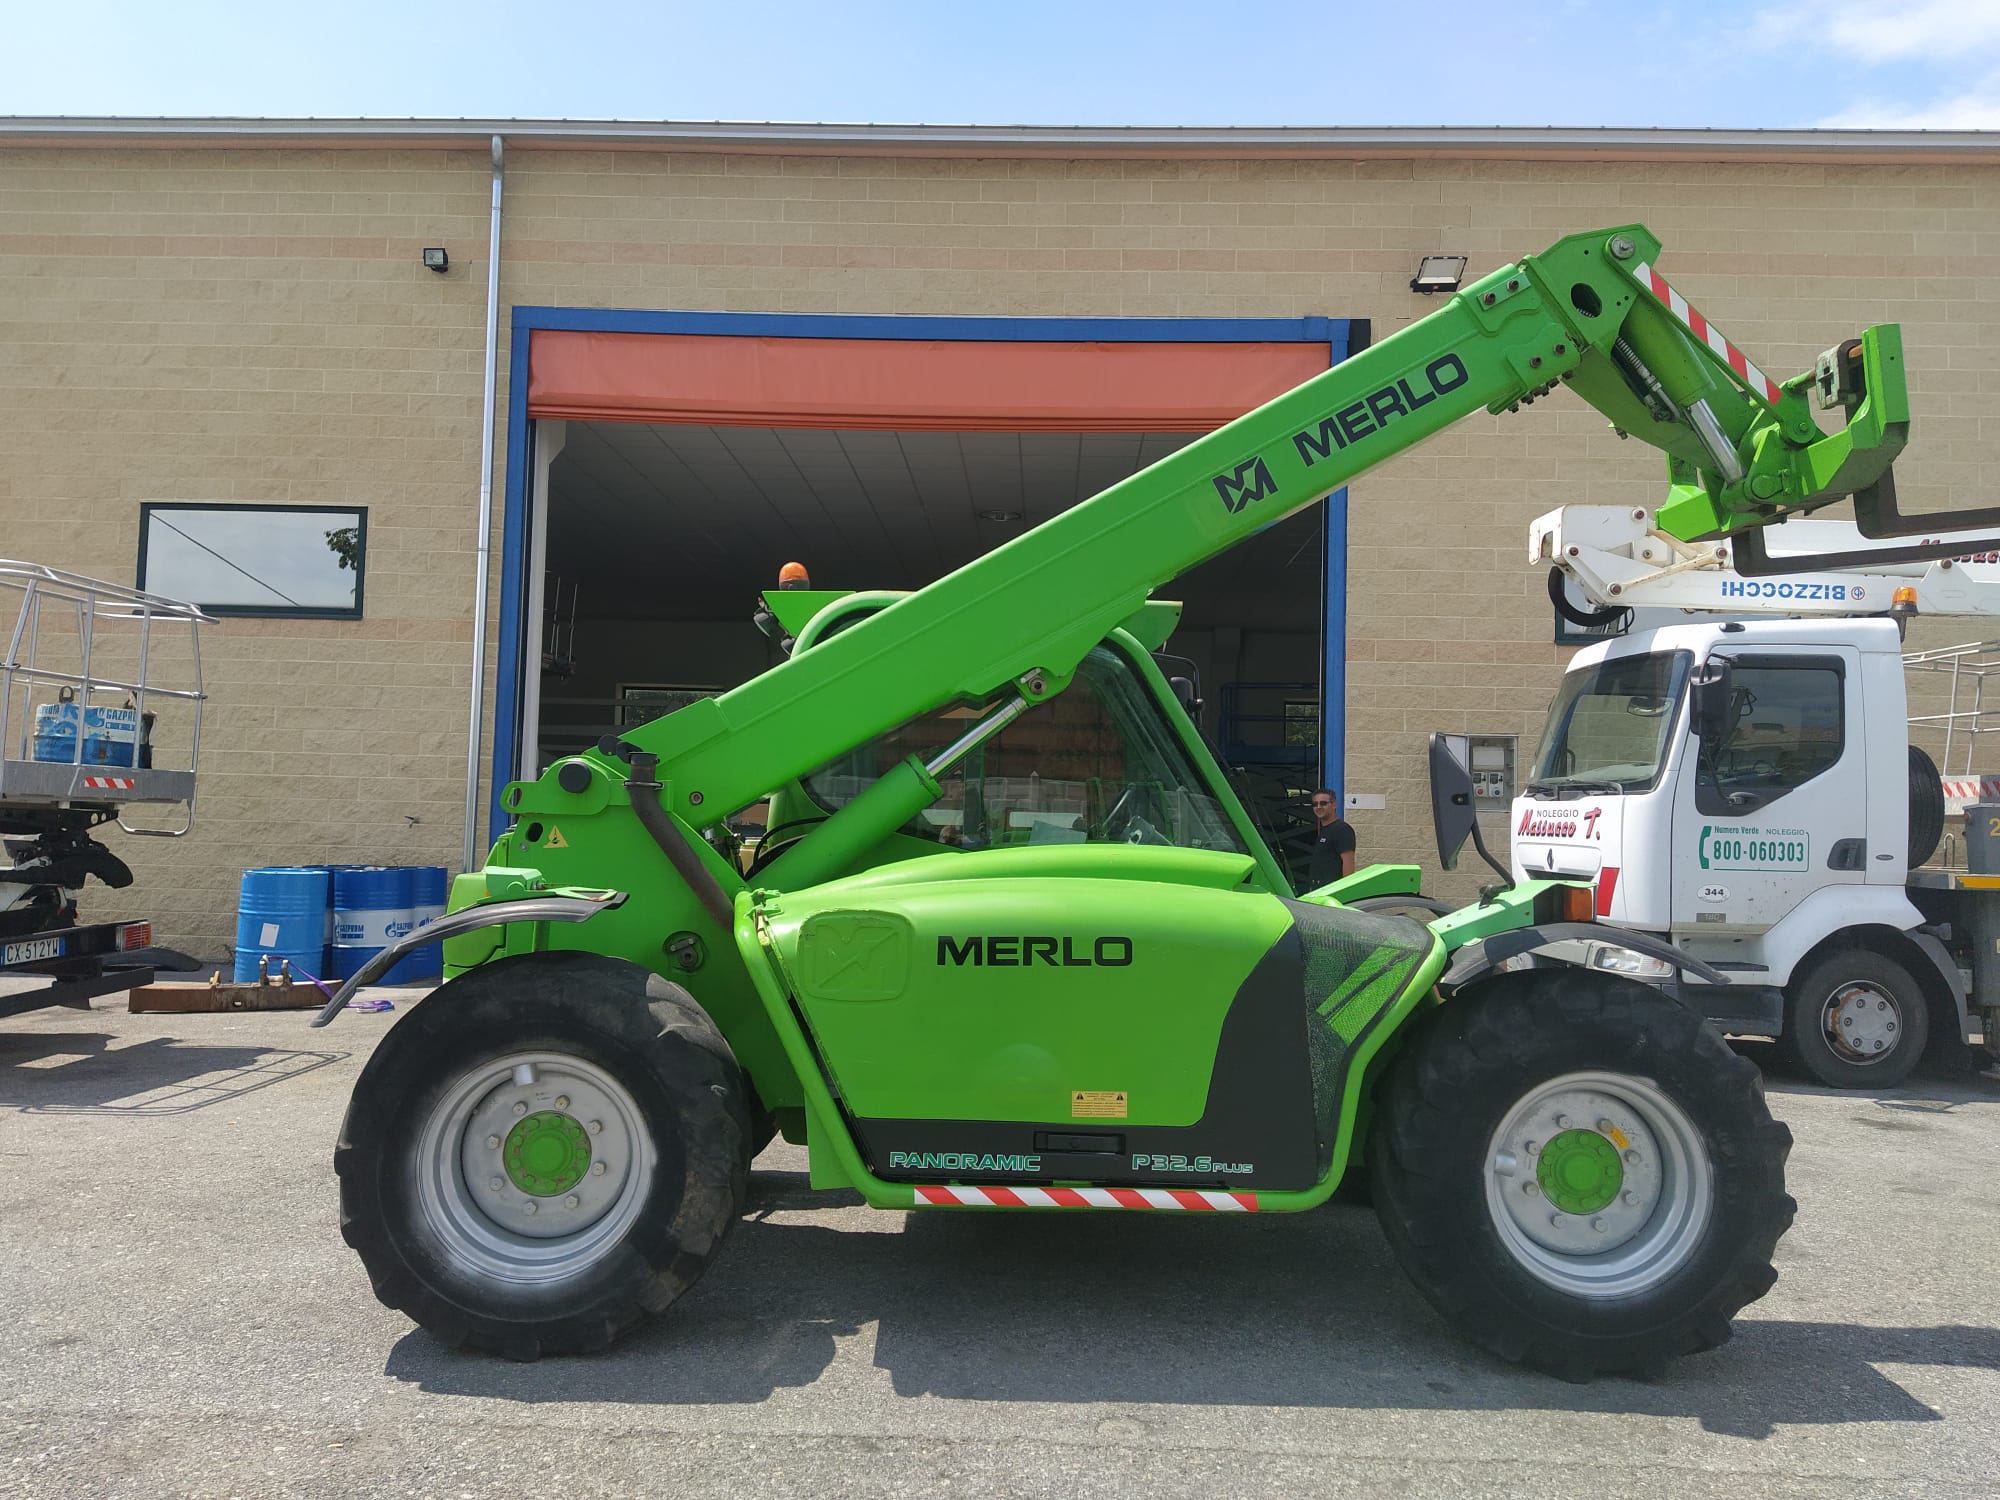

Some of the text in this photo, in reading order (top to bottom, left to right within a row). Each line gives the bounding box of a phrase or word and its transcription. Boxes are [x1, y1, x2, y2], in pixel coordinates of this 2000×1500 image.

[1292, 353, 1469, 467] MERLO
[1721, 581, 1846, 600] BIZZOCCHI
[106, 709, 136, 722] GAZPR
[1536, 809, 1579, 818] NOLEGGIO
[1583, 806, 1602, 841] T.
[1714, 825, 1806, 837] Numero Verde NOLEGGIO
[1713, 840, 1805, 862] 800-060303
[1704, 888, 1725, 897] 344
[936, 935, 1133, 967] MERLO
[889, 1151, 1041, 1172] PANORAMIC
